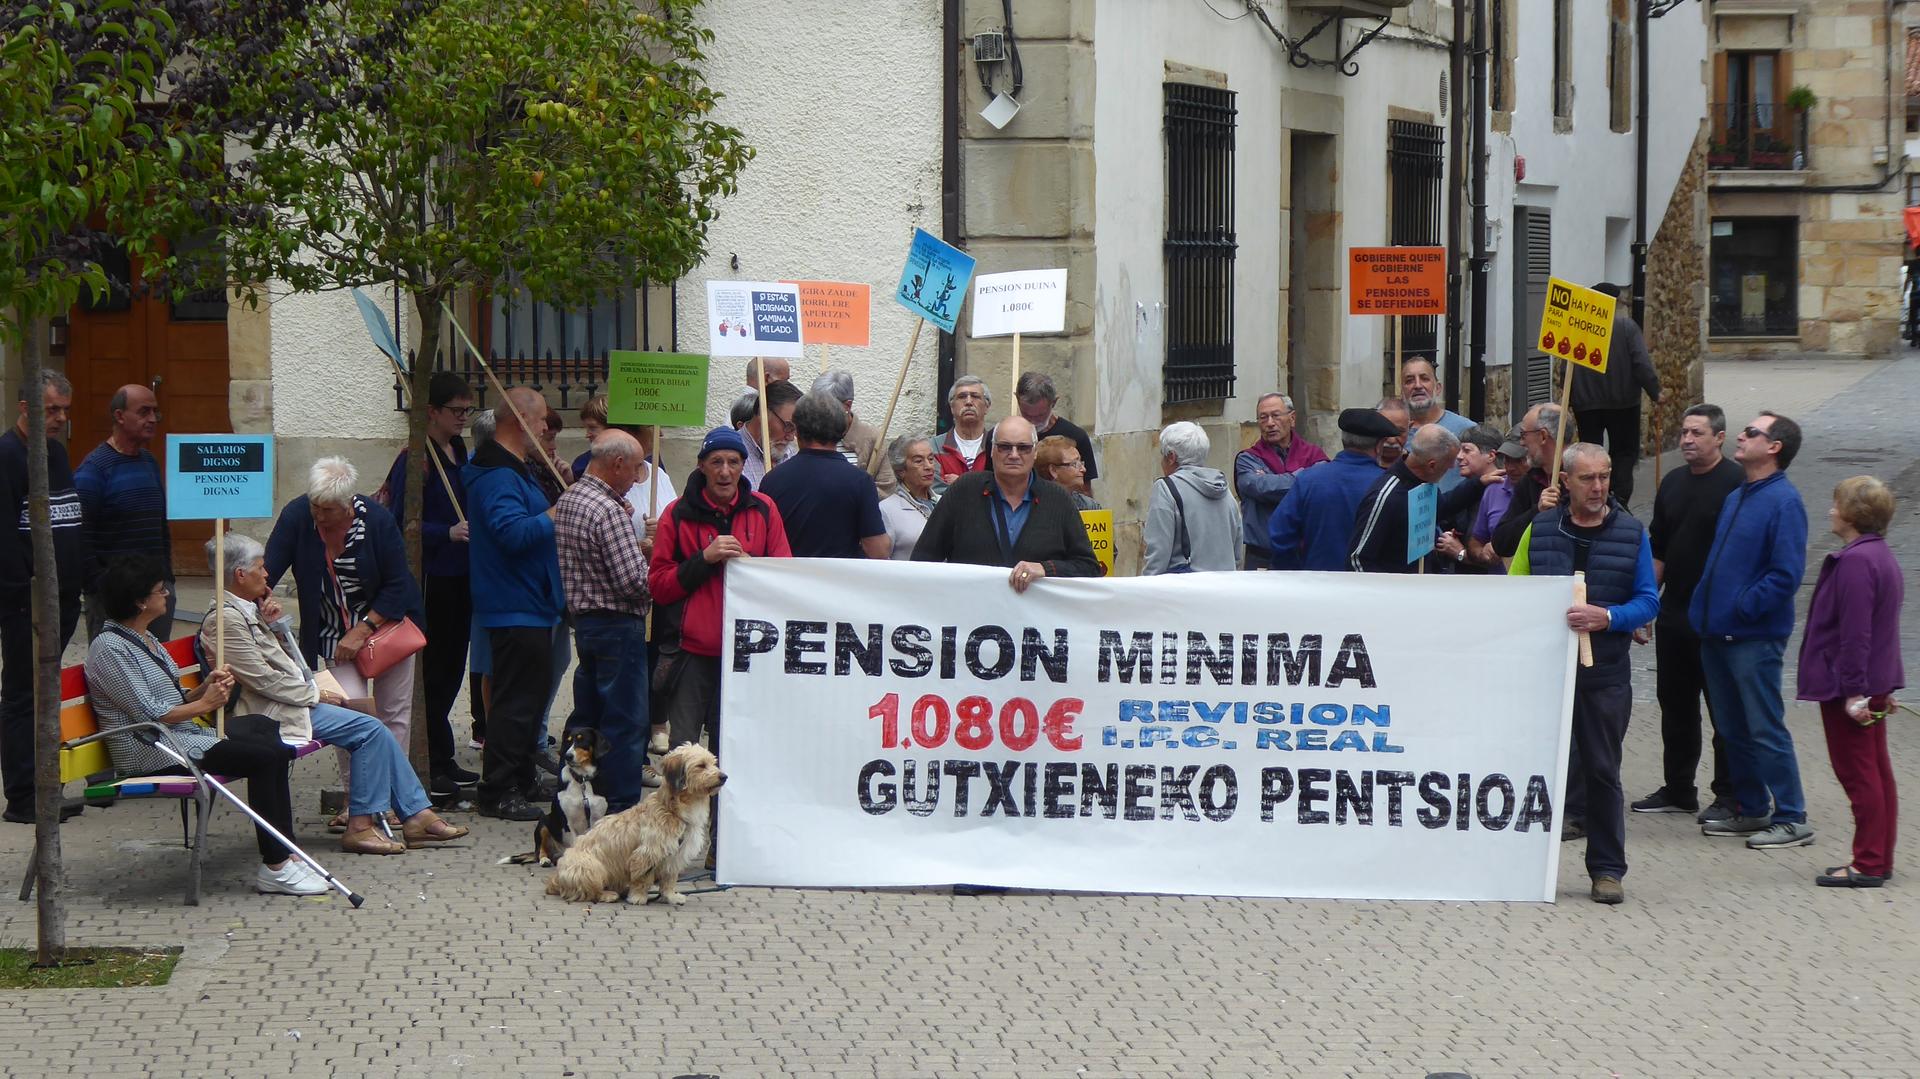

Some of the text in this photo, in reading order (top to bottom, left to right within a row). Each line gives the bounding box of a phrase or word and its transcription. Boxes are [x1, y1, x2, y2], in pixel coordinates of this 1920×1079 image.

[1354, 253, 1441, 263] GOBIERNE QUIEN
[1371, 264, 1424, 273] GOBIERNE
[1386, 275, 1409, 284] LAS
[979, 281, 1057, 295] PENSION DUINA
[1365, 288, 1430, 297] PENSIONES
[753, 303, 796, 313] INDIGNADO
[1002, 302, 1034, 312] 1.080€
[1357, 299, 1439, 308] SE DEFIENDEN
[1552, 287, 1609, 320] NO HAY PAN
[802, 310, 850, 318] APURTZEN
[1548, 307, 1564, 318] PARA
[757, 314, 794, 323] CAMINA A
[1546, 317, 1562, 328] TANTO
[760, 324, 793, 334] MI LADO.
[807, 321, 840, 329] DIZUTE
[1568, 316, 1607, 337] CHORIZO
[626, 376, 690, 387] GAUR ETA BIHAR
[634, 387, 660, 397] 1080€
[634, 401, 660, 411] 1200€
[197, 445, 246, 454] SALARIOS
[203, 457, 241, 467] DIGNOS
[195, 474, 249, 484] PENSIONES
[203, 486, 240, 496] DIGNAS
[1084, 522, 1107, 533] PAN
[732, 618, 1377, 688] PENSION MINIMA
[1119, 699, 1391, 728] REVISION
[868, 692, 1085, 751] 1.080€
[1102, 725, 1405, 754] I.P.C. REAL
[858, 758, 1553, 833] GUTXIENEKO PENTSIOA
